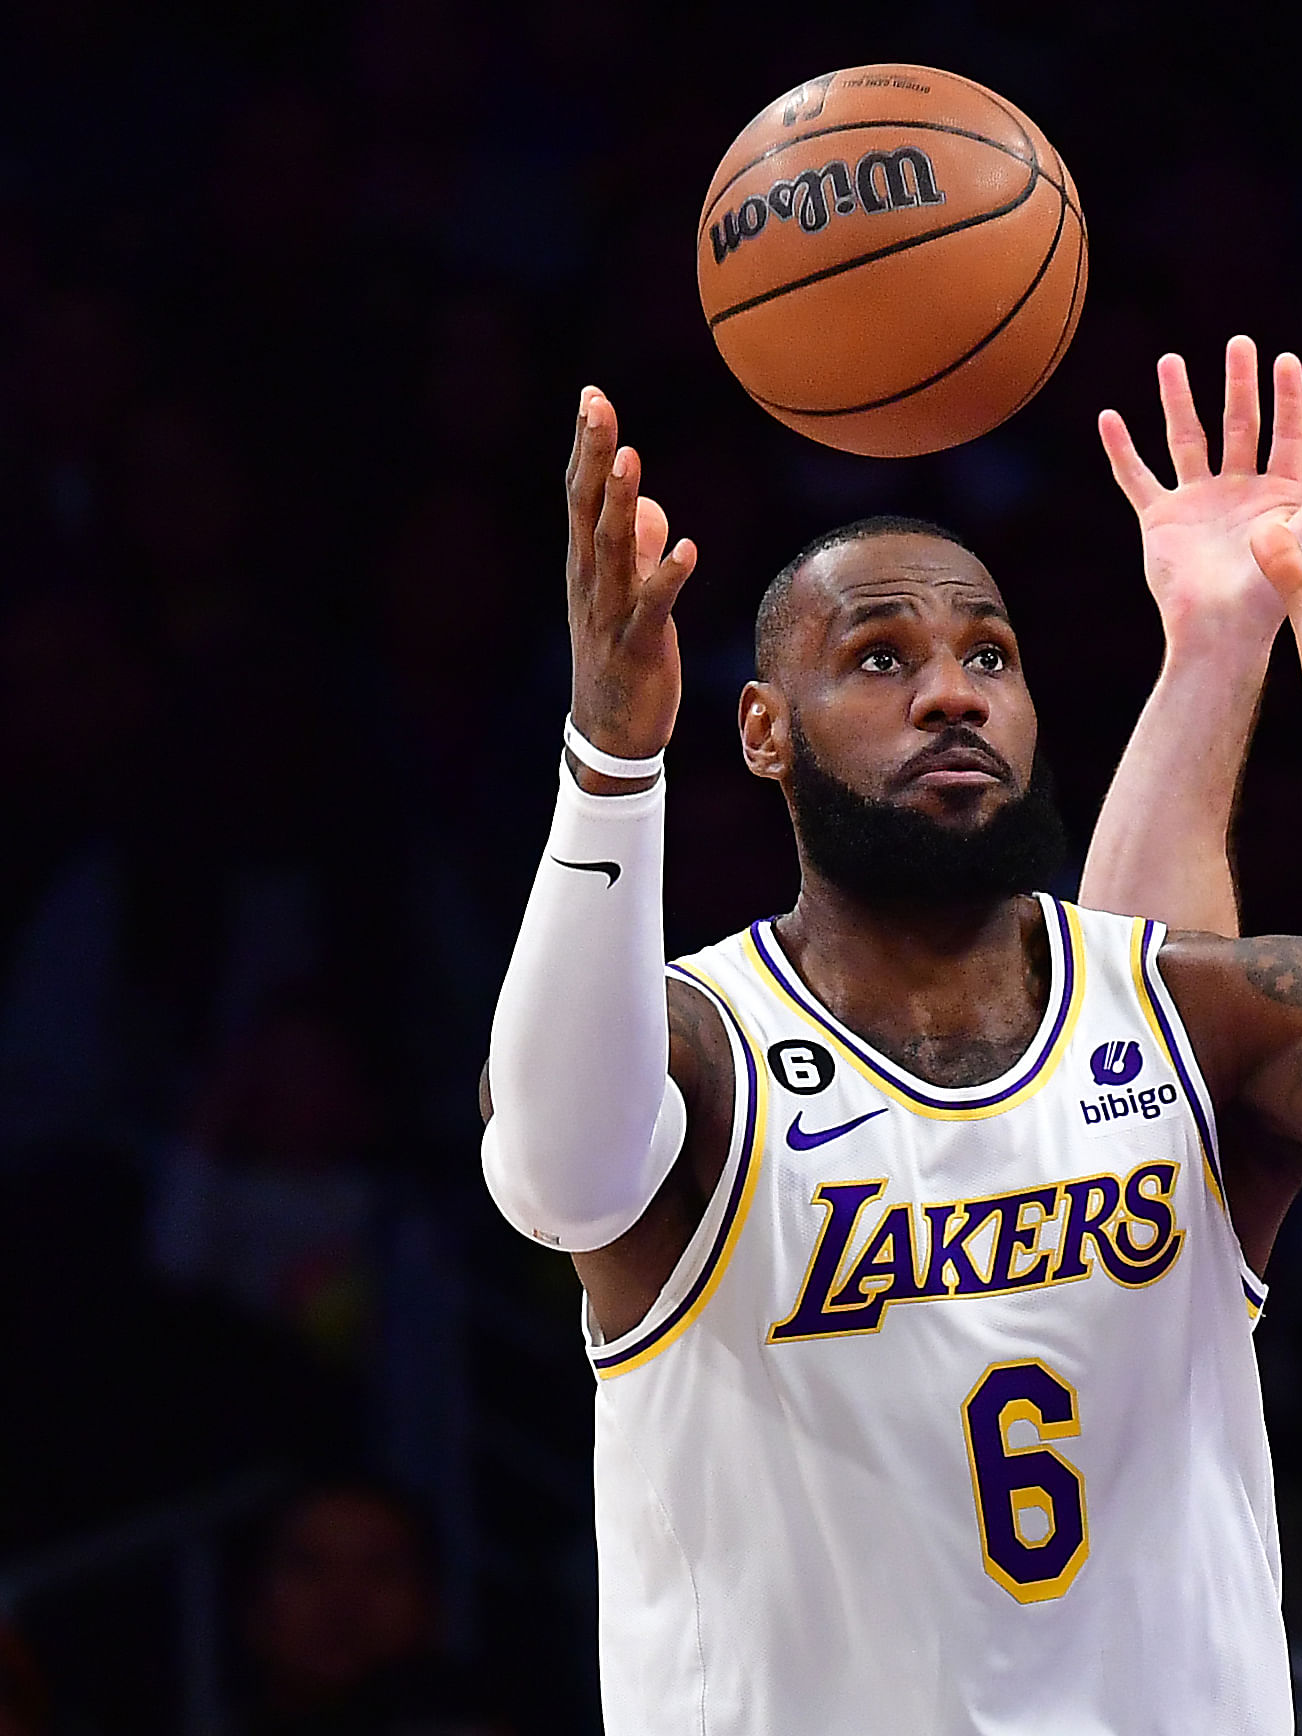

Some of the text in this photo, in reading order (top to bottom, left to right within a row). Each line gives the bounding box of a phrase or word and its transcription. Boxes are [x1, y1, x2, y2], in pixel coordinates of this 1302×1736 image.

[709, 146, 946, 265] Wilson
[776, 1046, 819, 1088] 6
[1079, 1082, 1178, 1125] bibigo
[766, 1161, 1187, 1345] LAKERS
[961, 1357, 1090, 1605] 6
